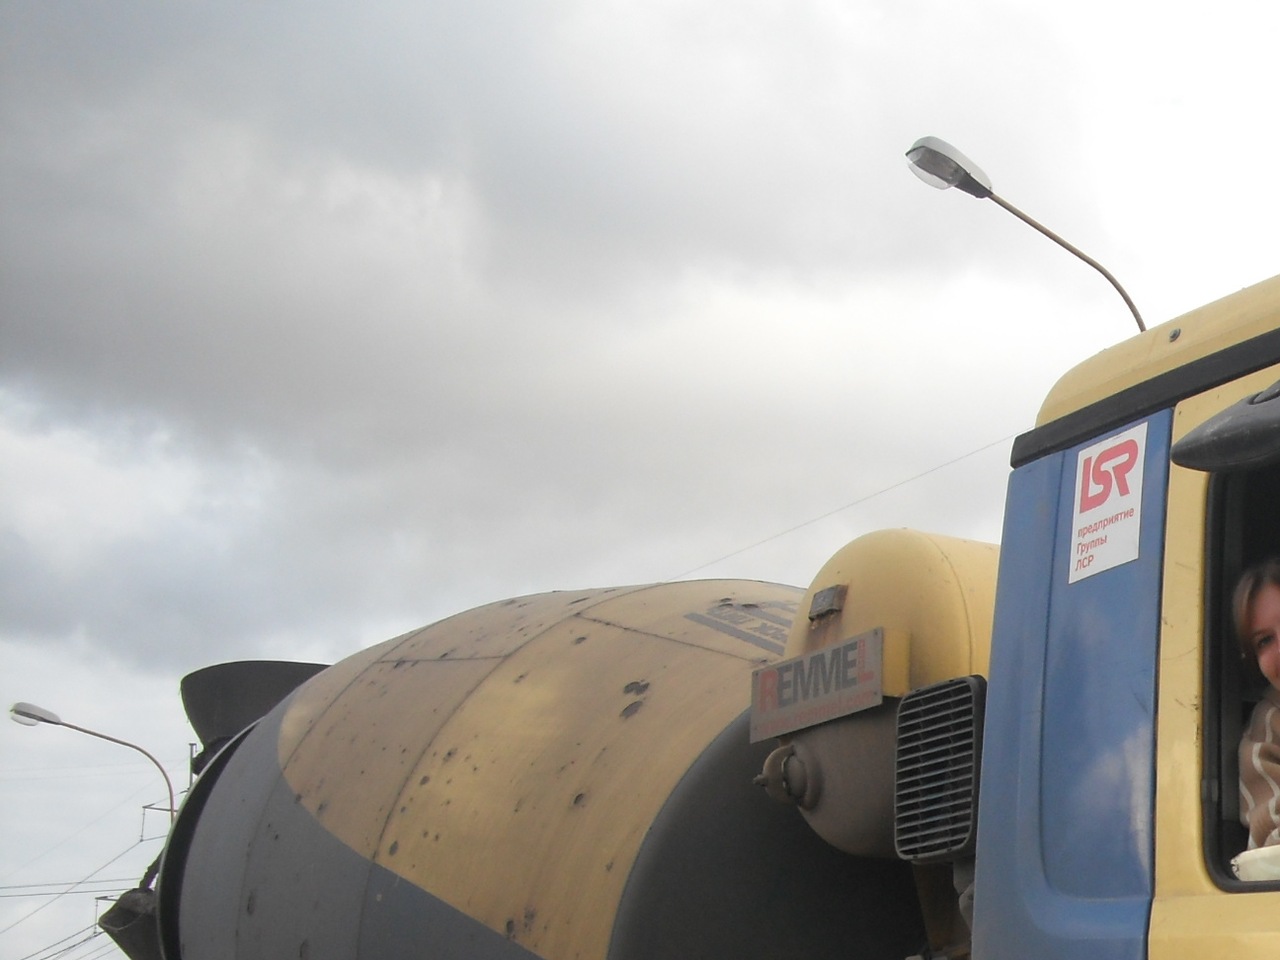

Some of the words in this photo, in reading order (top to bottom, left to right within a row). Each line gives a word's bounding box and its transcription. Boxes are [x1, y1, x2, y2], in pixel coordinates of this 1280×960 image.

[1077, 507, 1135, 539] предприятие
[1076, 535, 1108, 556] Группы
[1075, 554, 1095, 572] ЛСР
[759, 639, 875, 714] REMMEL
